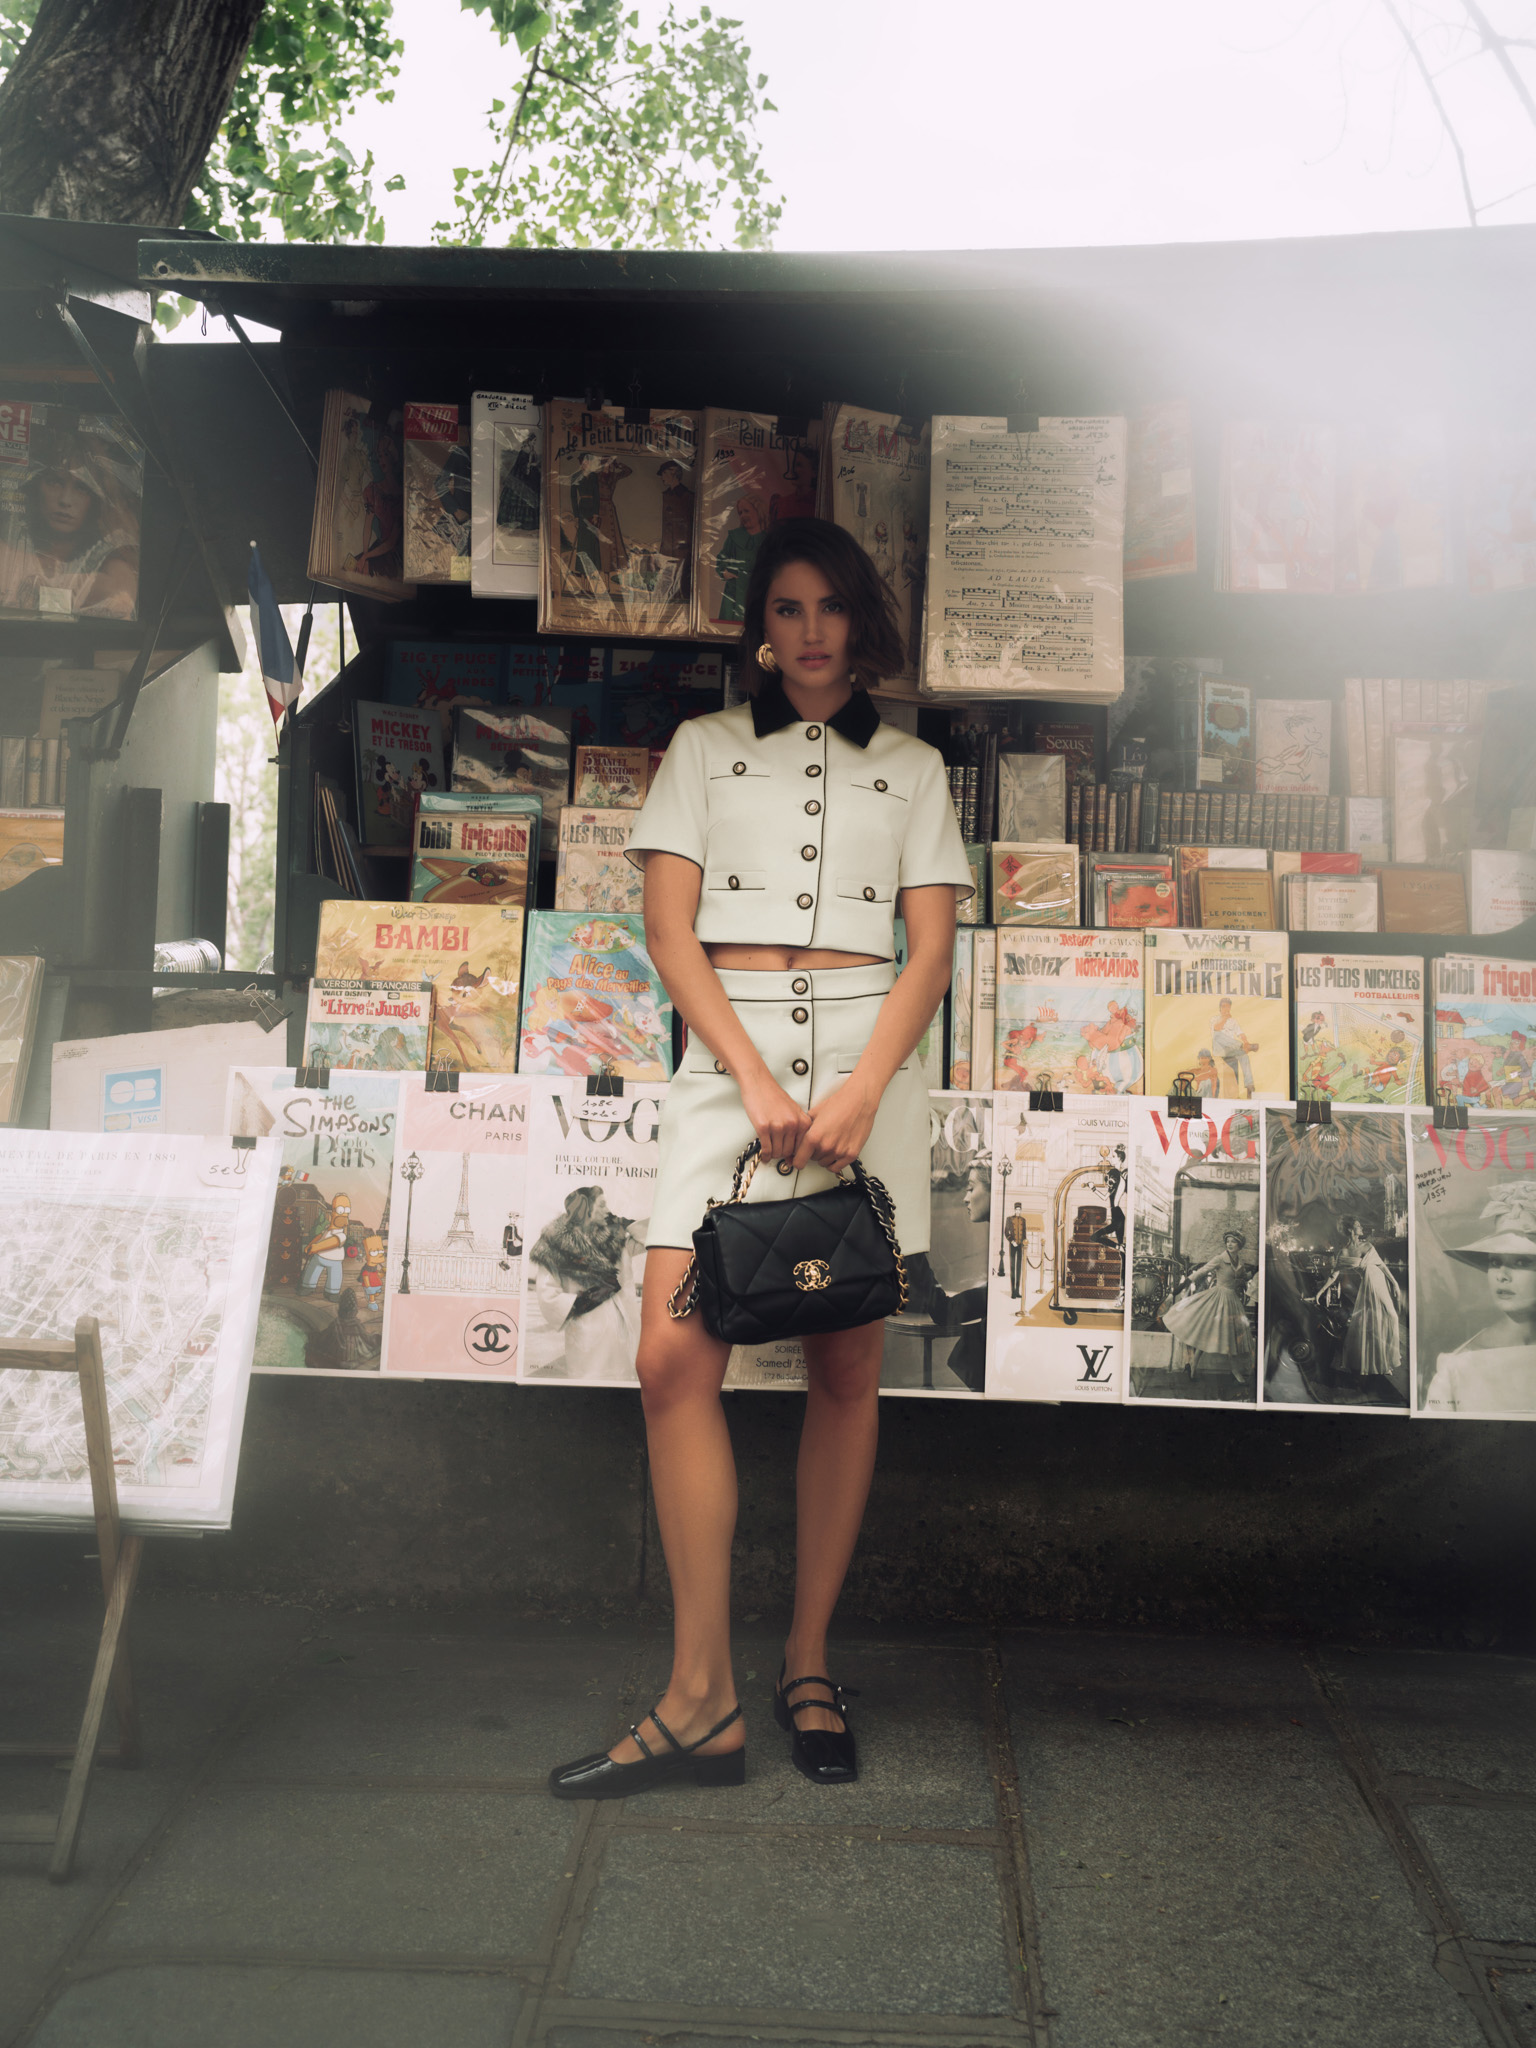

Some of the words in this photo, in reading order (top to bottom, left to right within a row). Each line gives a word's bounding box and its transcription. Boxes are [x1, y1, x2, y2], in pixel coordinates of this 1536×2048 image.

[581, 412, 612, 447] Petit
[739, 419, 765, 448] Petit
[400, 652, 426, 664] ZIG
[431, 654, 448, 663] ET
[454, 653, 496, 665] PUCE
[619, 661, 649, 672] ZIG
[371, 718, 430, 740] MICKEY
[372, 735, 383, 746] ET
[385, 736, 396, 748] LE
[1046, 735, 1085, 750] Sexus
[583, 766, 599, 774] DES
[602, 767, 640, 775] CASTORS
[592, 775, 630, 783] JUNIORS
[420, 821, 452, 849] bibi
[461, 823, 527, 852] fricotin
[569, 824, 590, 845] LES
[592, 826, 626, 846] PIEDS
[374, 924, 470, 951] BAMBI
[1084, 951, 1101, 959] ET
[1104, 951, 1129, 960] LES
[569, 954, 614, 978] Alice
[615, 969, 630, 980] au
[1003, 952, 1070, 977] Astérix
[1075, 957, 1140, 979] NORMANDS
[1192, 961, 1199, 970] LA
[1200, 958, 1247, 971] FORTERESSE
[1248, 963, 1256, 972] DE
[547, 977, 573, 991] Pays
[575, 976, 594, 990] des
[595, 979, 650, 994] Merveilles
[1154, 959, 1284, 1000] MAKILING
[1300, 966, 1321, 988] LES
[1324, 967, 1360, 989] PIEDS
[1440, 962, 1475, 996] bibi
[323, 980, 363, 989] VERSION
[371, 981, 422, 992] FRANÇAISE
[1354, 991, 1420, 1000] FOOTBALLEURS
[326, 999, 364, 1015] Livre
[375, 1000, 420, 1019] Jungle
[137, 1114, 158, 1124] VISA
[283, 1098, 395, 1137] SIMPSONS
[450, 1101, 526, 1123] CHAN
[1078, 1118, 1098, 1126] LOUIS
[485, 1132, 523, 1142] PARIS
[1150, 1110, 1256, 1160] VOG
[1319, 1134, 1339, 1142] PARIS
[57, 1151, 74, 1160] DE
[80, 1150, 118, 1160] PARIS
[124, 1152, 141, 1161] EN
[148, 1152, 177, 1161] 1889
[312, 1133, 376, 1169] Paris
[555, 1154, 582, 1163] HAUTE
[585, 1156, 623, 1164] COUTURE
[555, 1164, 610, 1177] L'ESPRIT
[1210, 1168, 1254, 1181] LOUVRE
[1415, 1167, 1443, 1180] AUDREY
[1417, 1171, 1452, 1190] HEPBURN
[756, 1357, 792, 1368] Samedi
